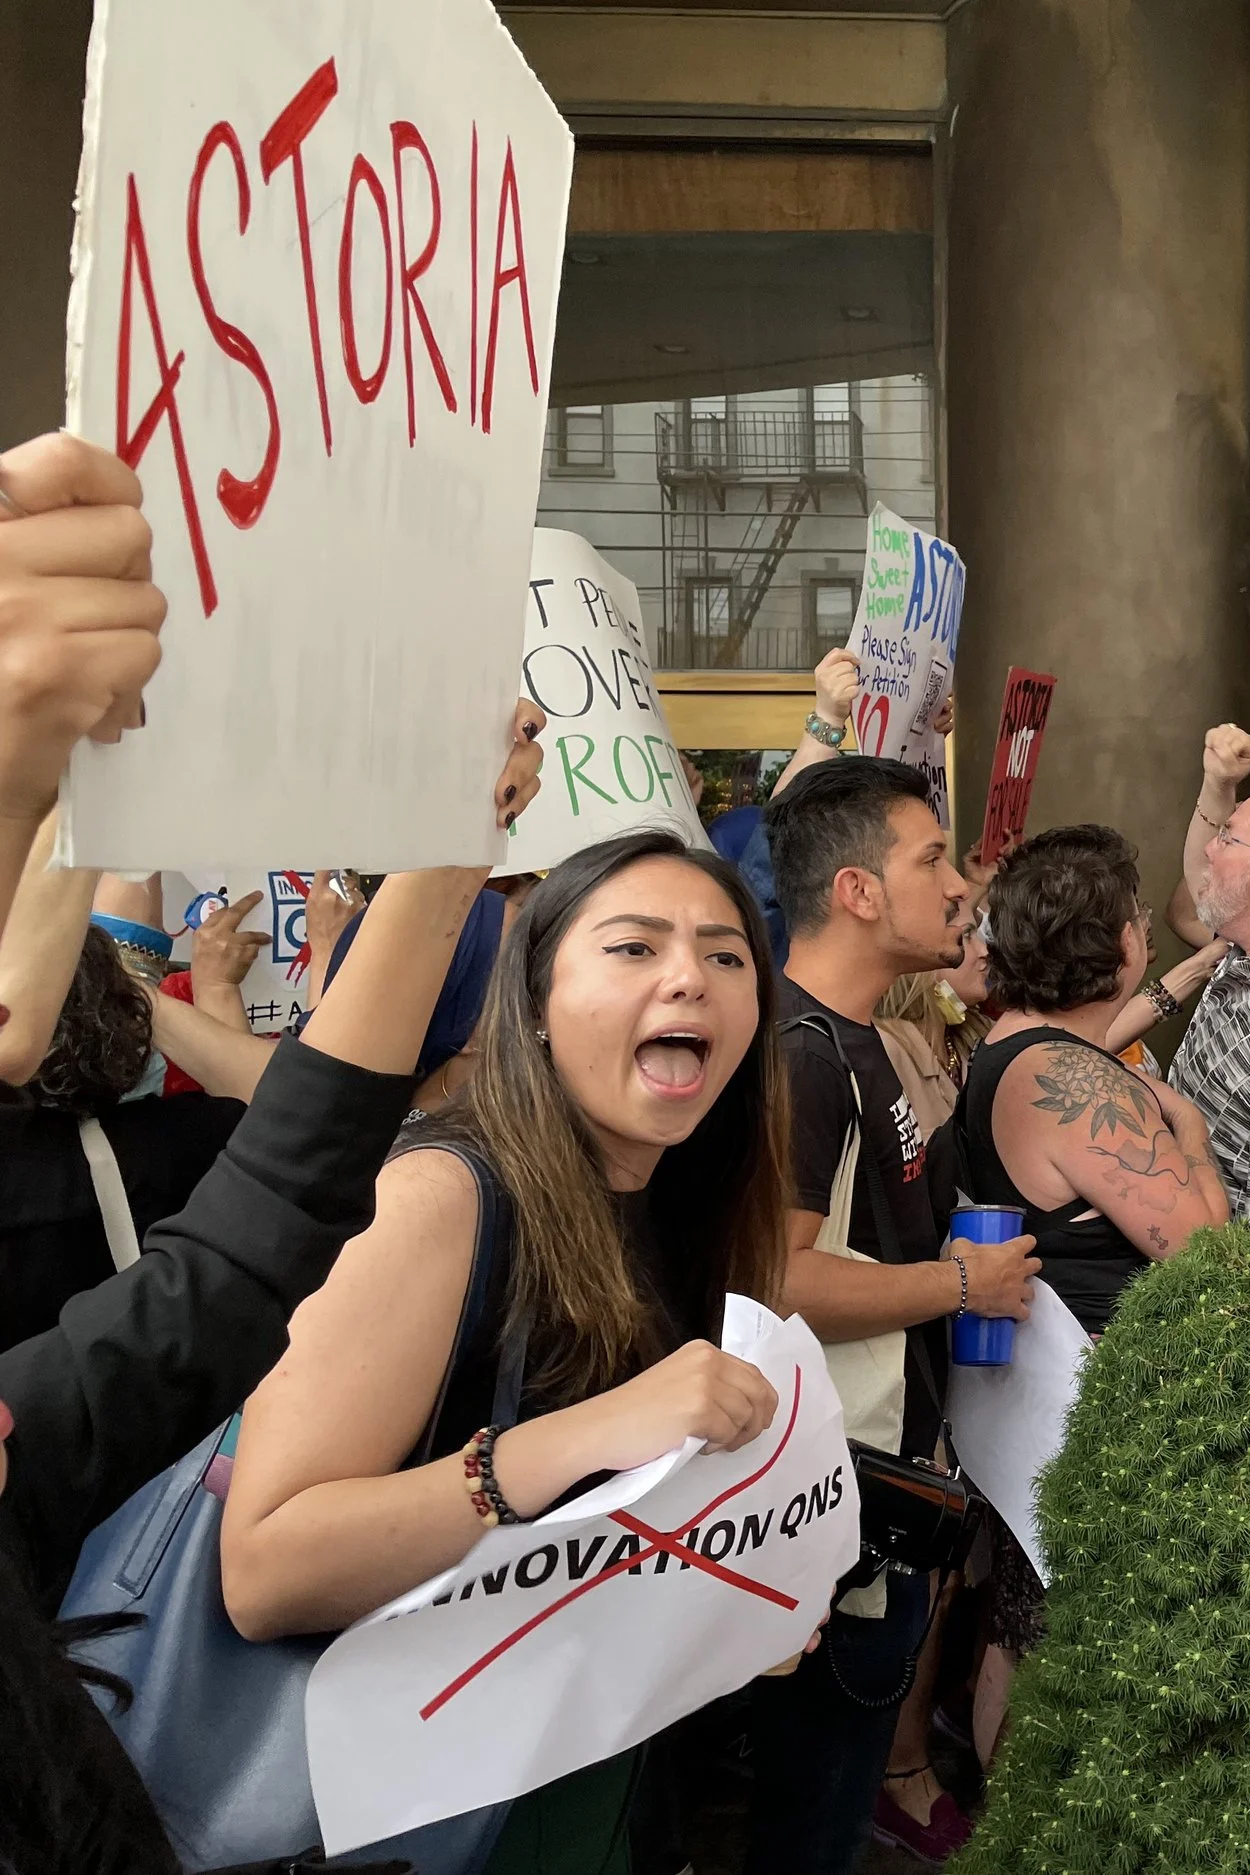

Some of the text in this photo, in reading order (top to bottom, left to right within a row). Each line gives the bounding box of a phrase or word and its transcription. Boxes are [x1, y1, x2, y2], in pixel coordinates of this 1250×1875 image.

[116, 56, 538, 618] ASTORIA
[861, 625, 897, 665] Please
[871, 666, 910, 702] Petition
[1006, 726, 1035, 779] NOT
[779, 1465, 844, 1540] QNS
